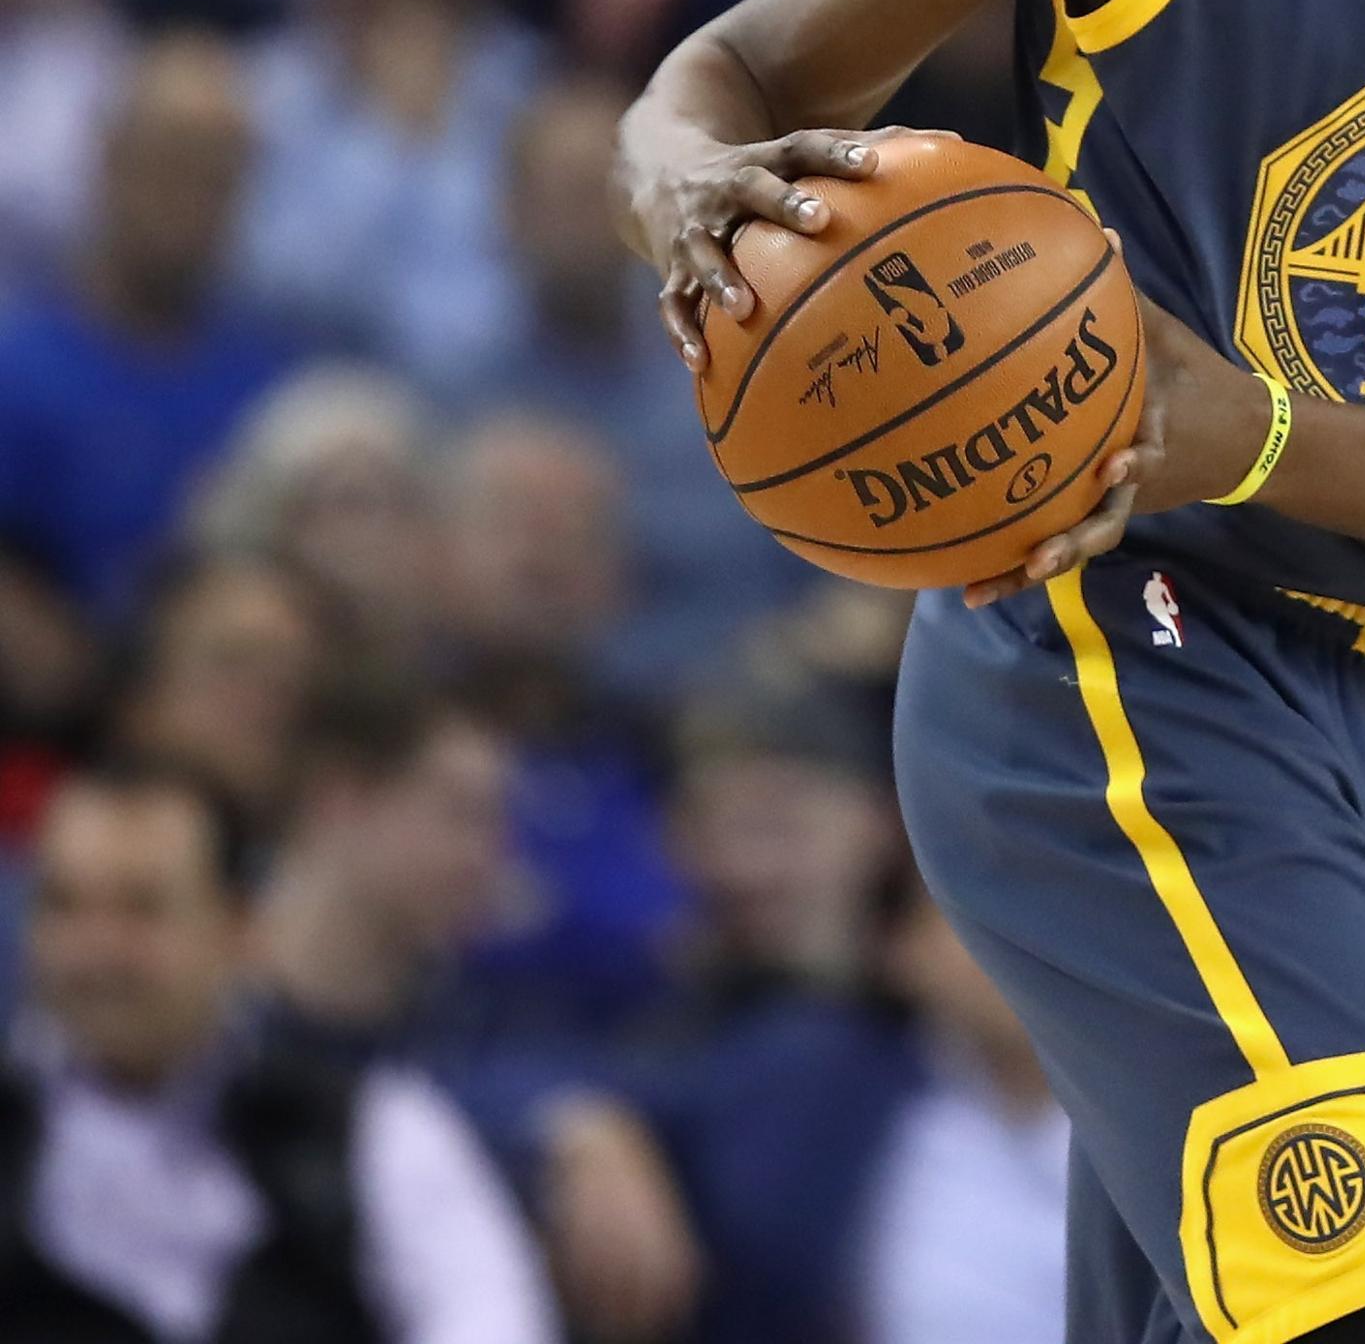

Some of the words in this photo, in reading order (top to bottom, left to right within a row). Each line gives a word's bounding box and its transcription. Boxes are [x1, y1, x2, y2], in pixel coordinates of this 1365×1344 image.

[878, 255, 909, 282] NBA
[996, 241, 1037, 272] OFFICIAL
[947, 276, 976, 299] BALL
[970, 259, 1001, 287] GAME
[846, 306, 1118, 528] SPALDING
[1259, 430, 1284, 474] JOHN
